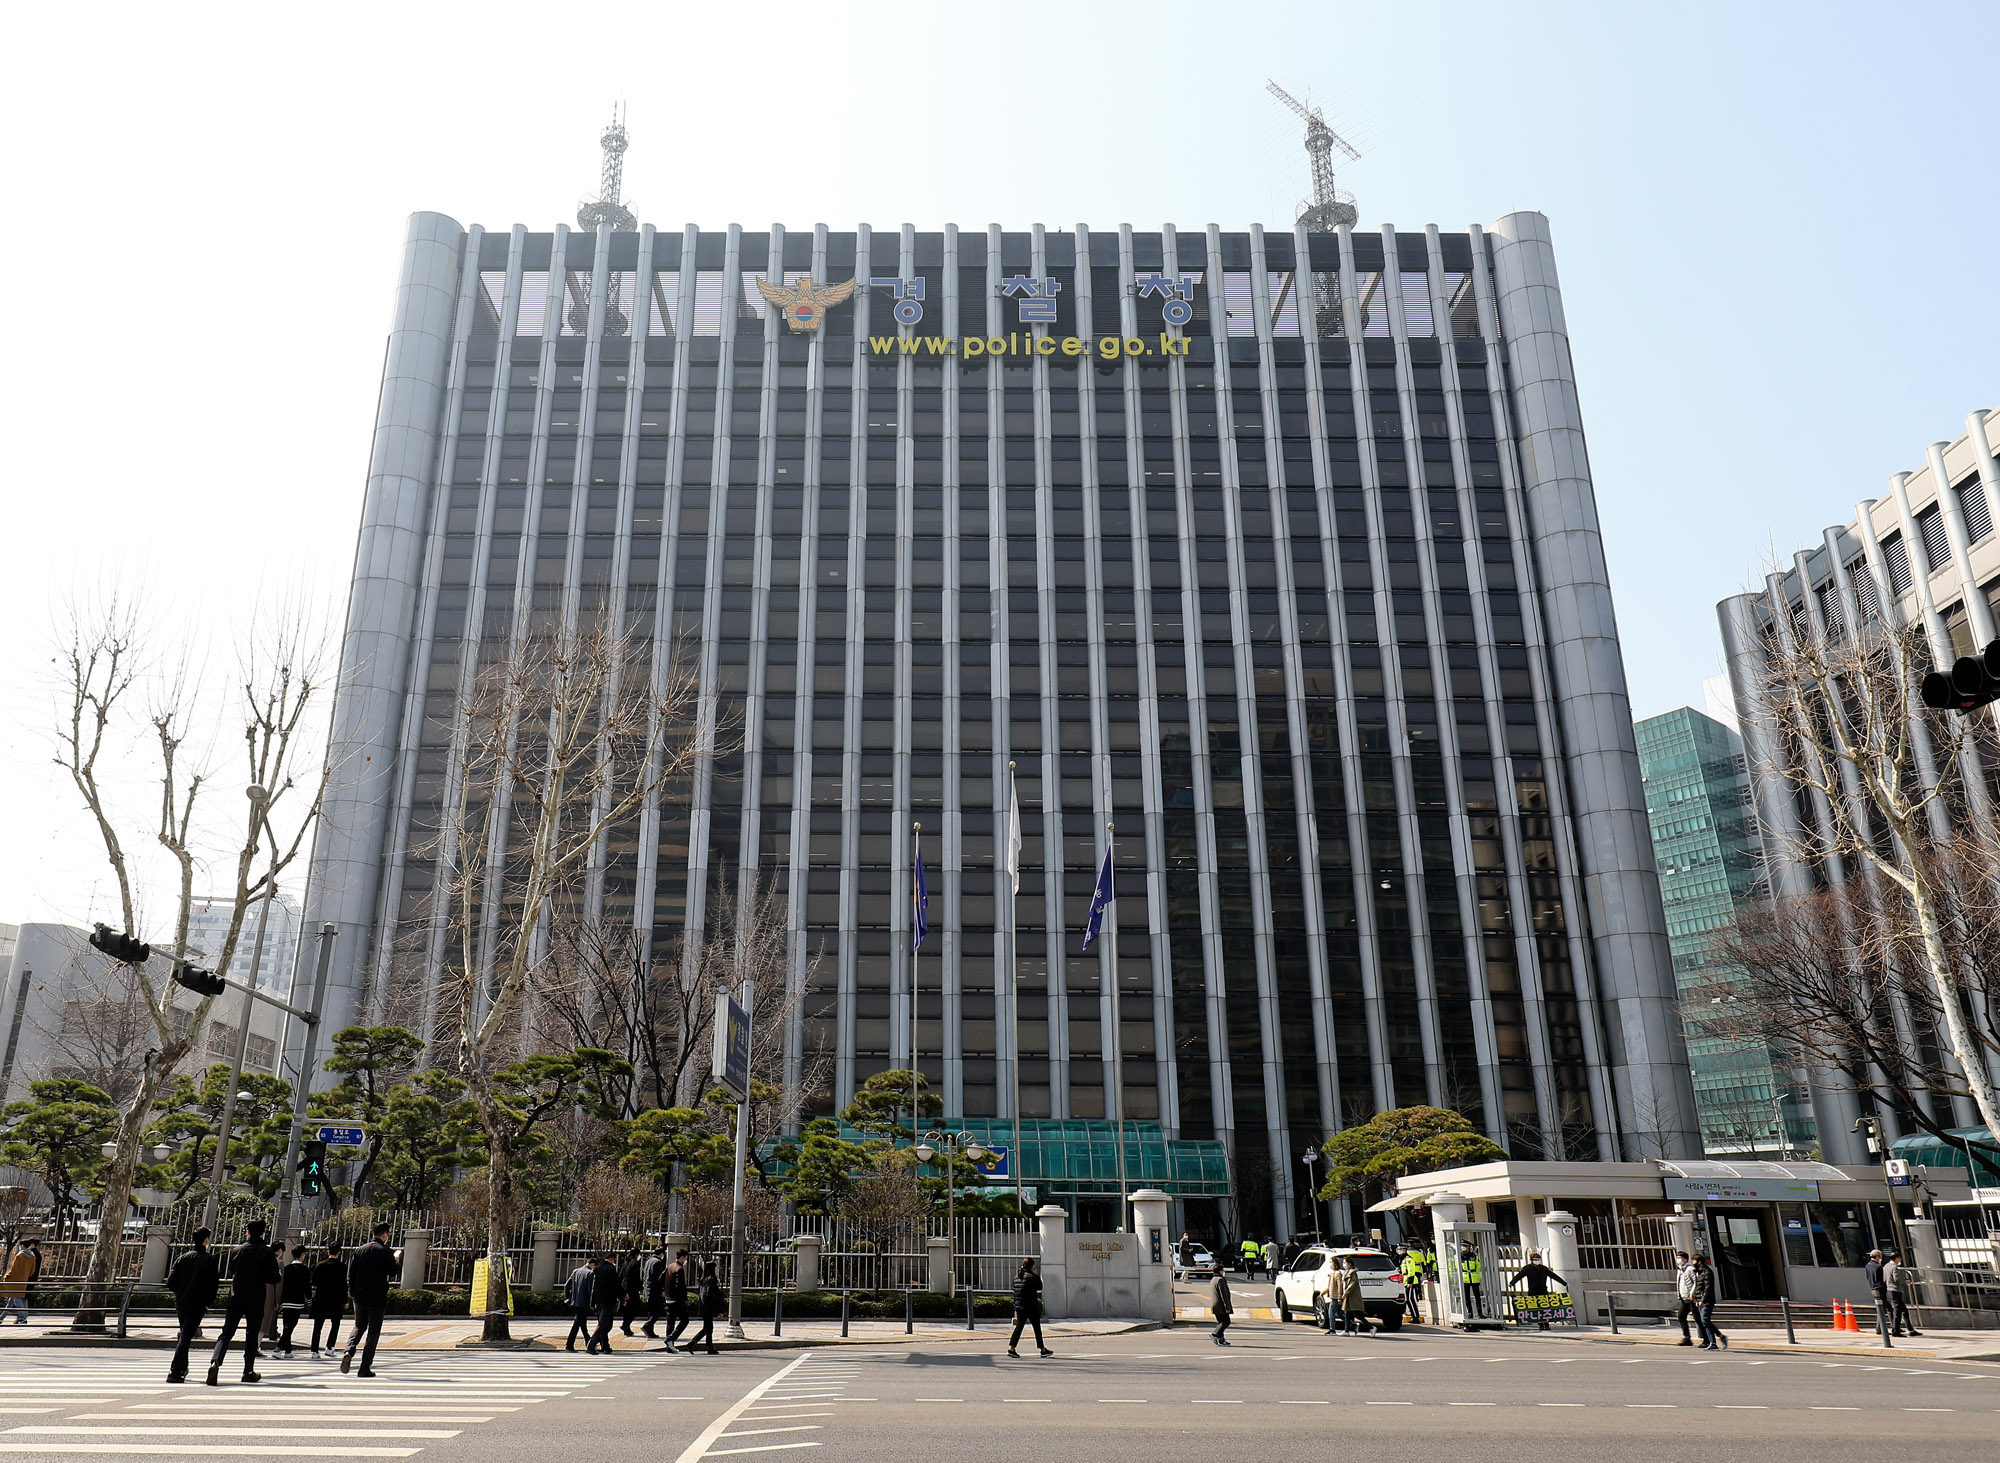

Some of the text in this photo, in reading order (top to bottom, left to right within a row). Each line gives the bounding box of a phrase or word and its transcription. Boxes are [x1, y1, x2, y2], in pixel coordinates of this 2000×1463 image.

[869, 274, 1195, 326] 경찰청
[868, 331, 1193, 360] www.police.go.kr
[1079, 1242, 1125, 1252] National Police
[1092, 1252, 1113, 1262] Agency
[1513, 1292, 1573, 1310] 경찰청장님
[1518, 1307, 1576, 1323] 만나주세요
